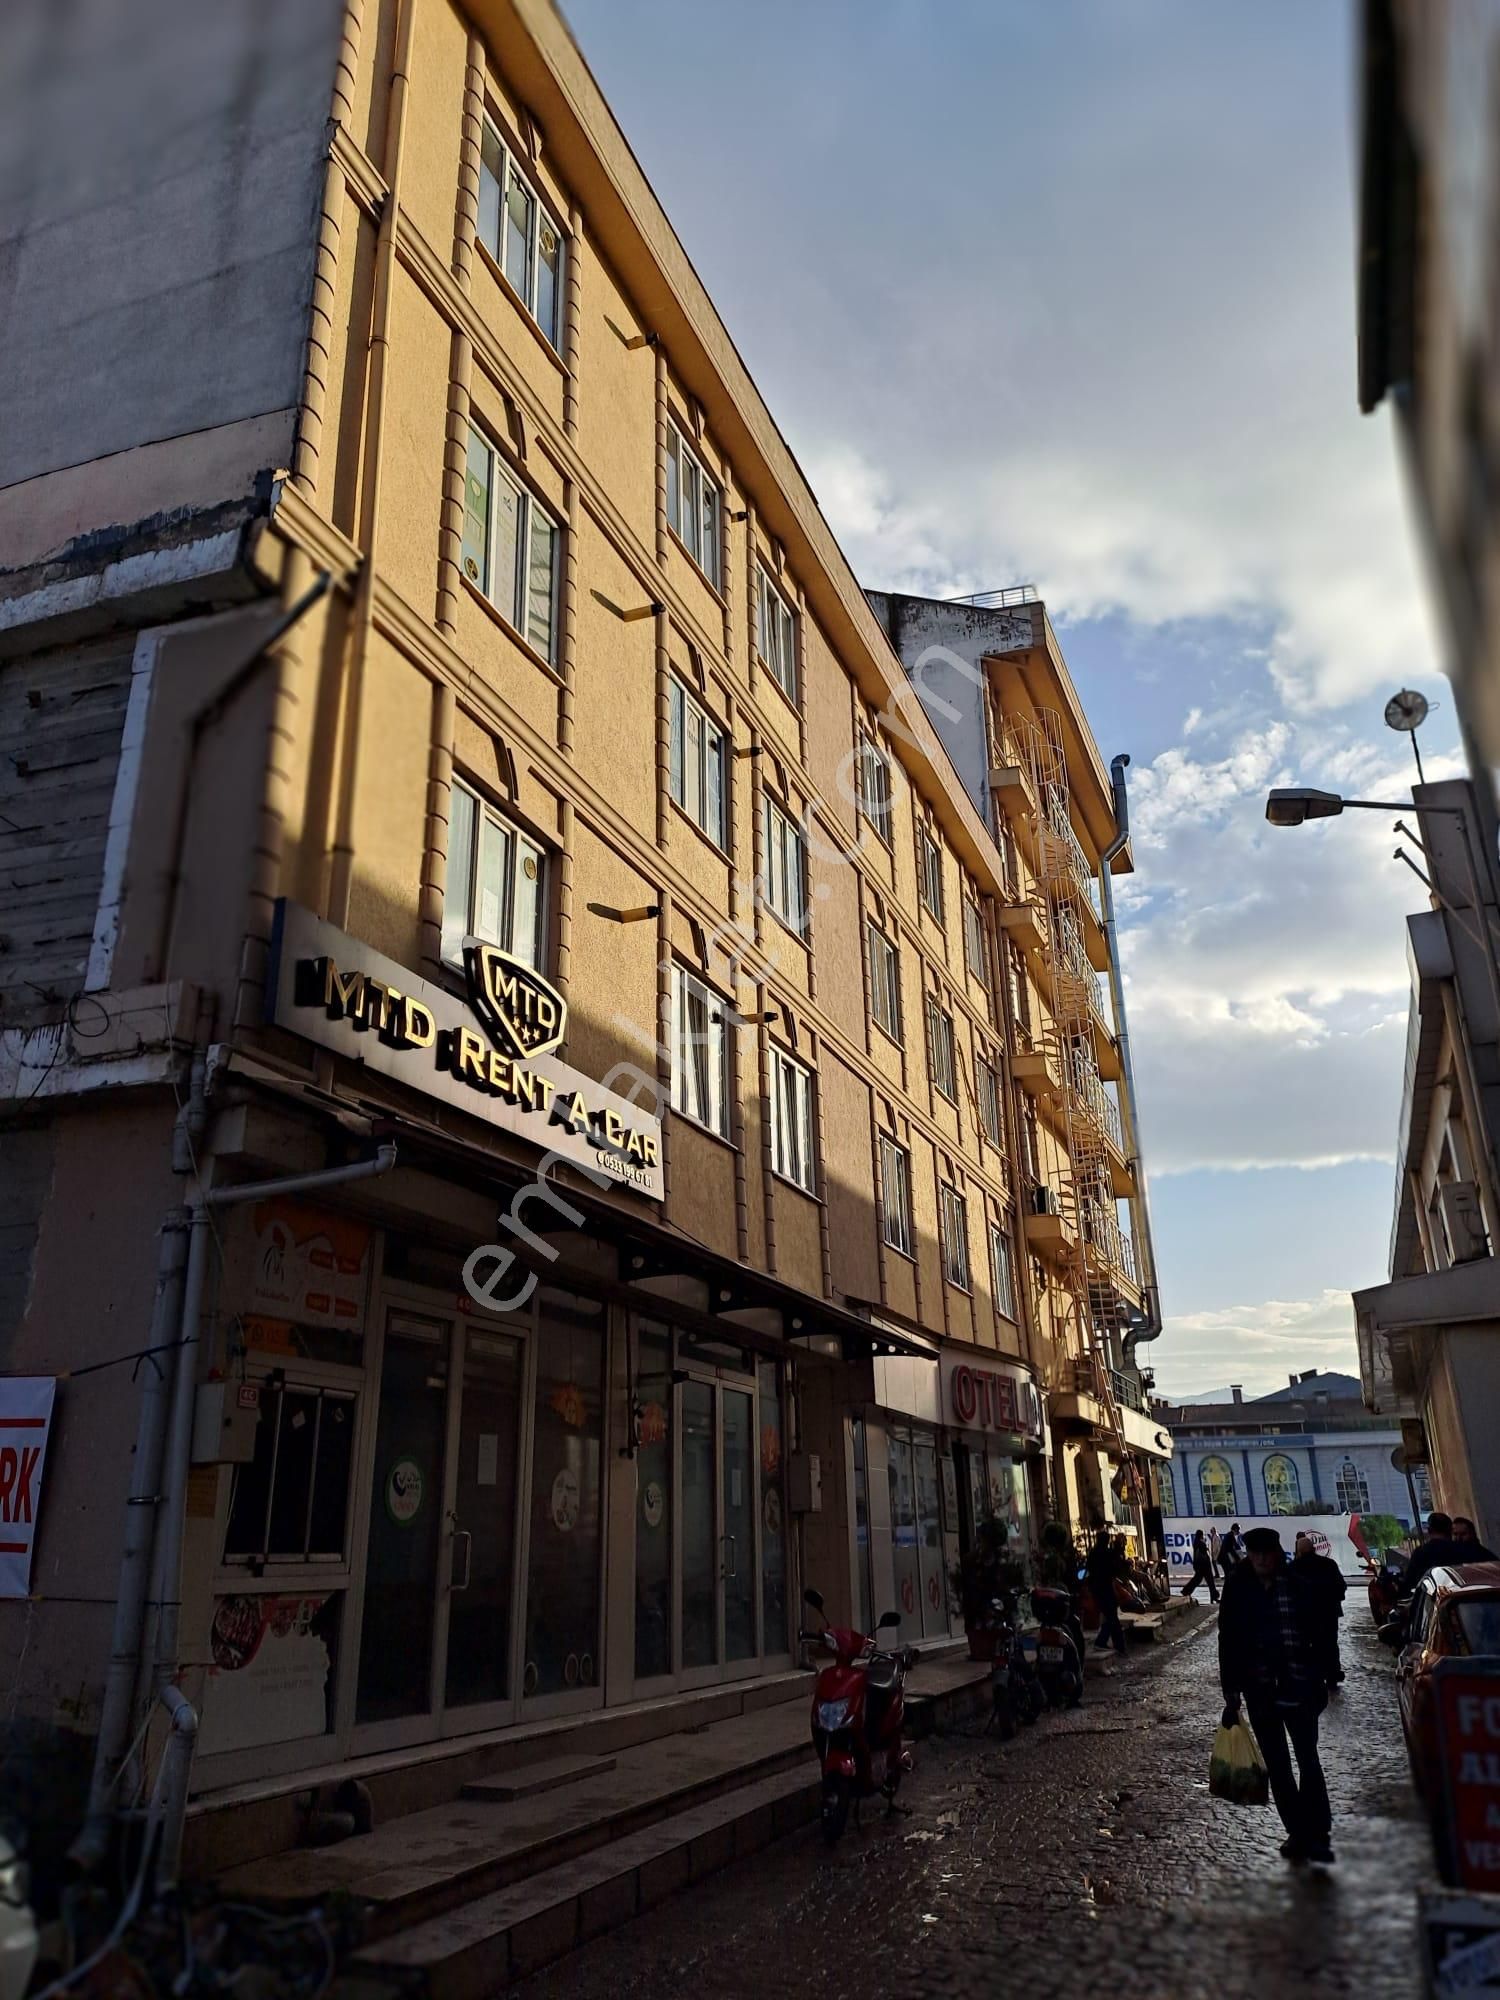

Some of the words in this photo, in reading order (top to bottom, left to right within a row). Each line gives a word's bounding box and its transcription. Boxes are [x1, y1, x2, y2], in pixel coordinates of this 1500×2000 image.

[495, 964, 556, 1030] MTD
[320, 956, 436, 1049] MTD
[456, 1026, 556, 1111] RENT
[605, 1110, 659, 1167] CAR
[953, 1365, 1028, 1432] OTEL
